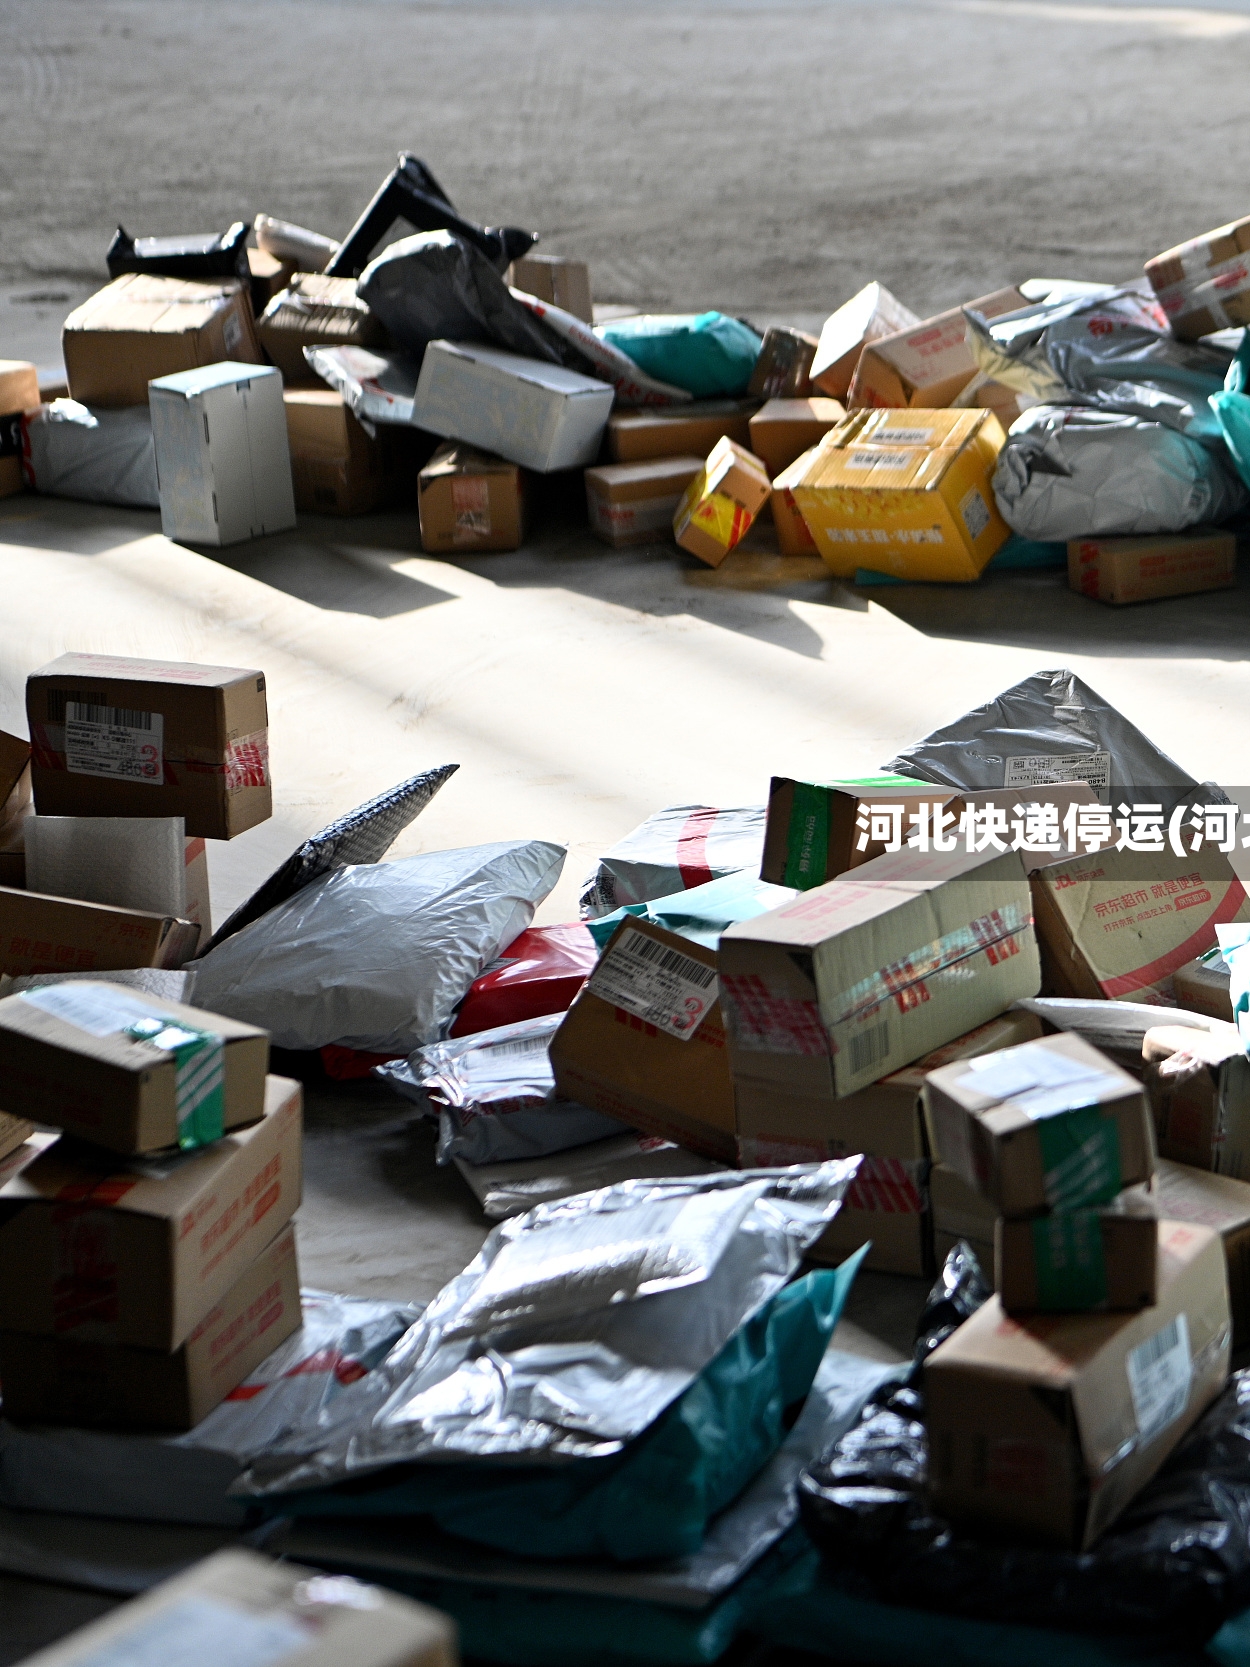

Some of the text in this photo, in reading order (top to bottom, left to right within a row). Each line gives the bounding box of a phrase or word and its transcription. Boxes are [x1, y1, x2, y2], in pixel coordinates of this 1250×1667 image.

[1054, 873, 1077, 891] JDL
[1093, 872, 1205, 918] 京东超市 就是便宜
[1103, 903, 1173, 933] 打开京东 点击左上角
